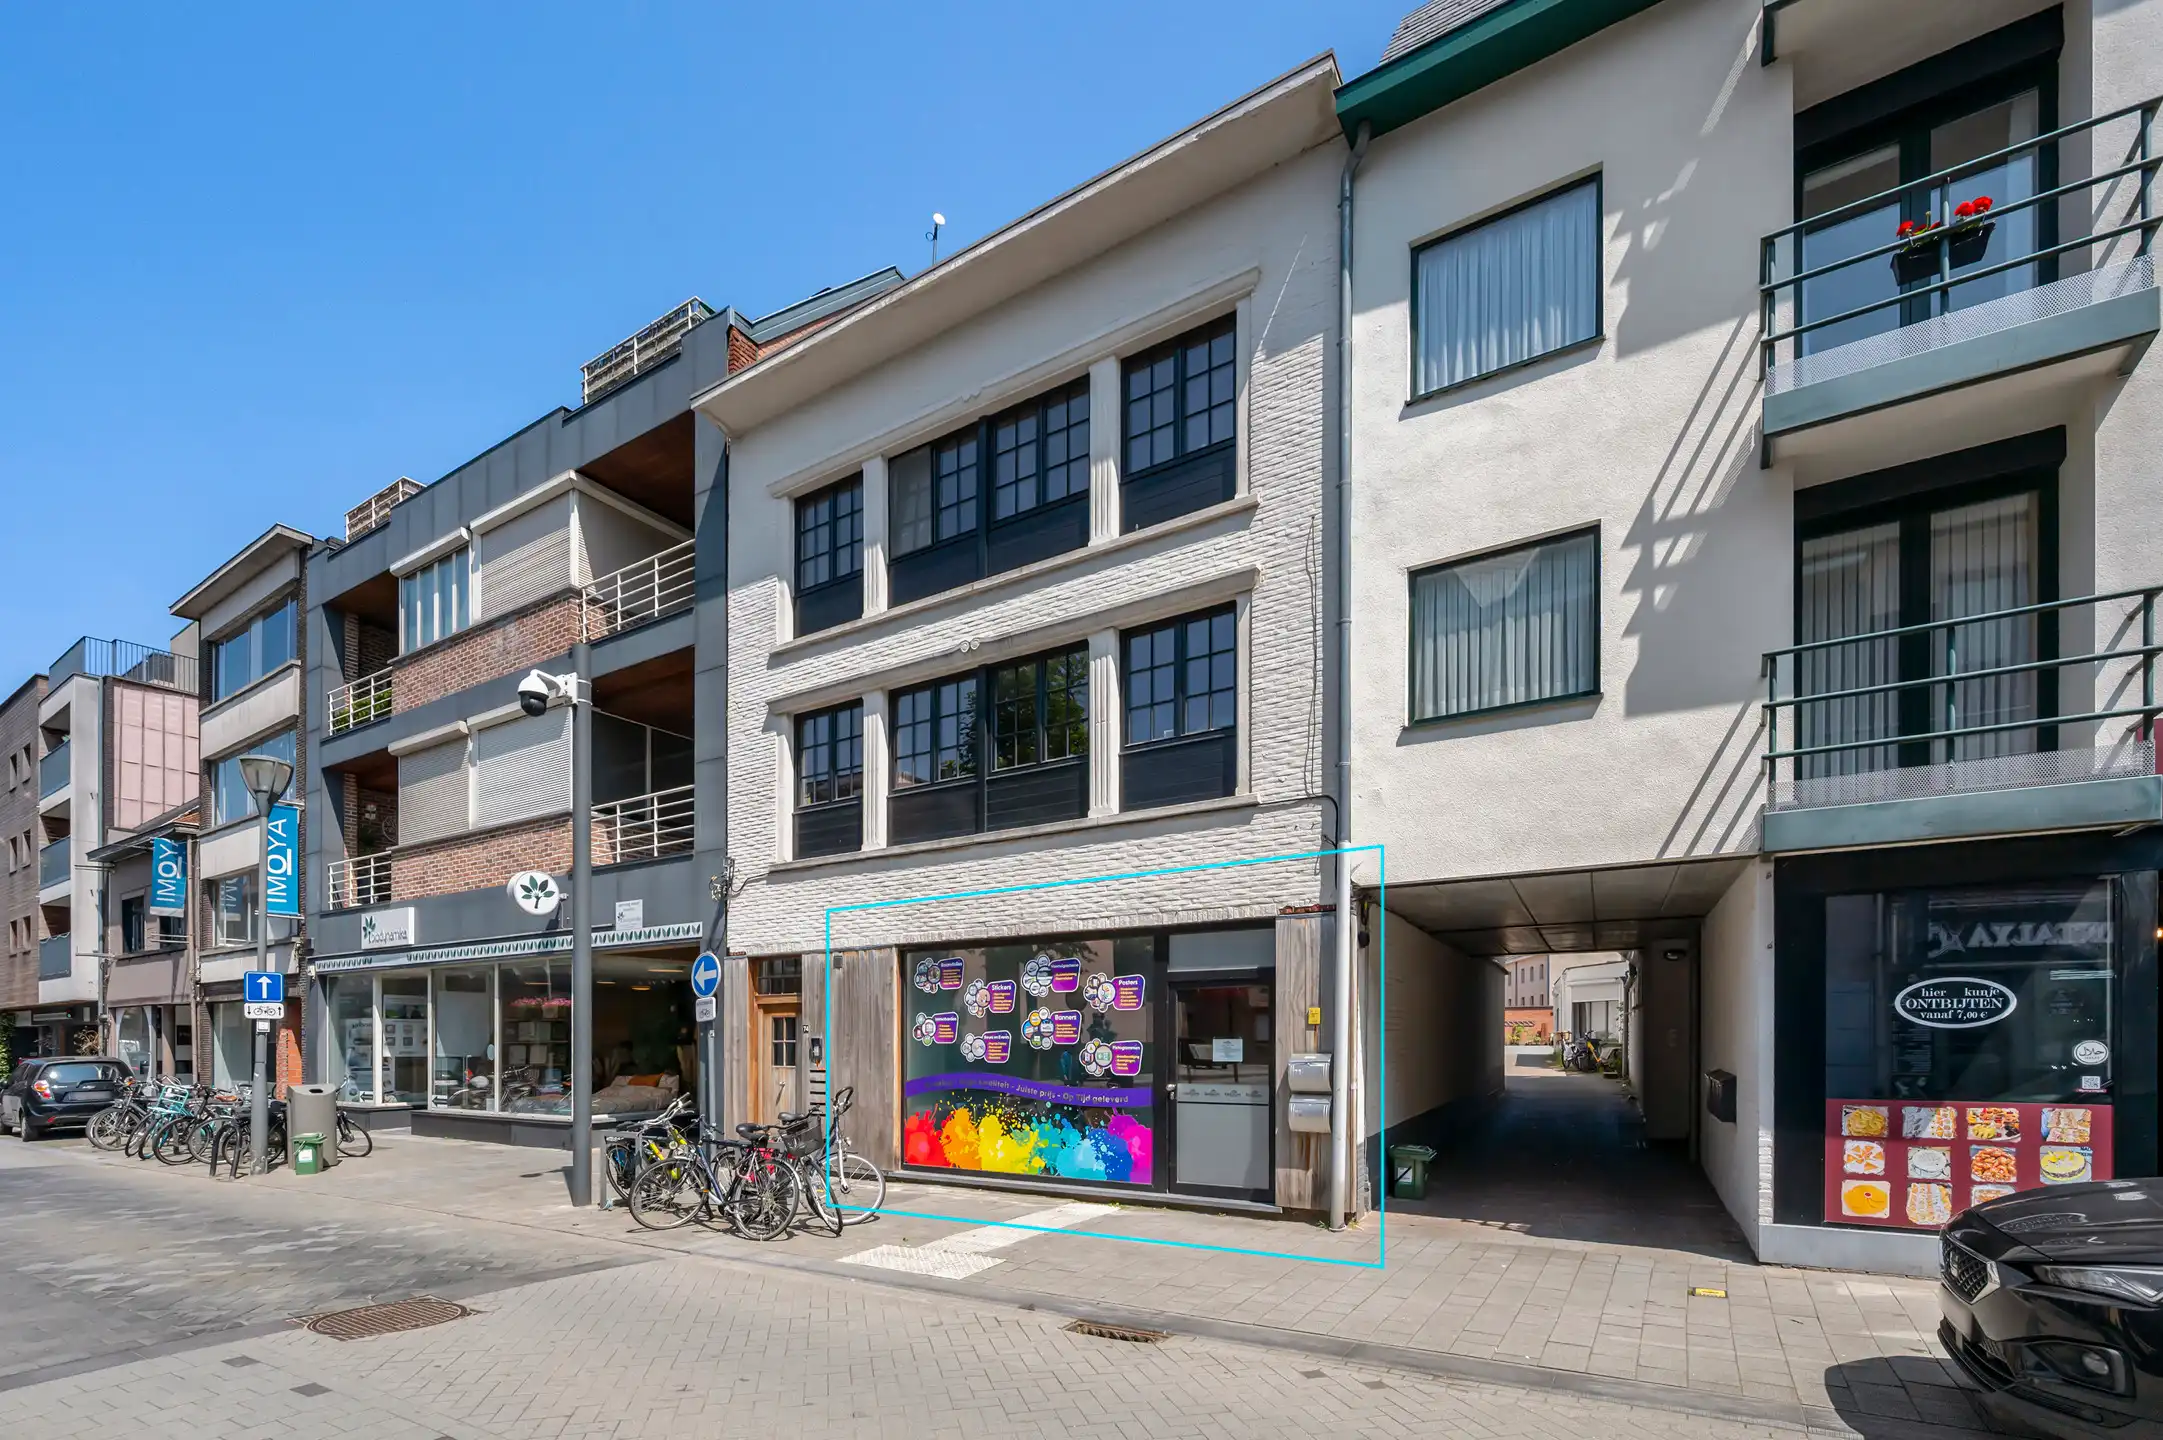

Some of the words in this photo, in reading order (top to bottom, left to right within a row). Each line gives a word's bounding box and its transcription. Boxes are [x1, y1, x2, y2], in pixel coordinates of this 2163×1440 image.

[1921, 987, 1946, 997] hier
[1905, 997, 2004, 1010] ONTBIJTEN
[1920, 1009, 1954, 1019] vanaf
[1956, 1010, 1978, 1020] 7,00
[1016, 1084, 1038, 1095] Juiste
[1039, 1090, 1056, 1100] prijs
[1076, 1094, 1091, 1104] Tijd
[1092, 1095, 1129, 1105] geleverd
